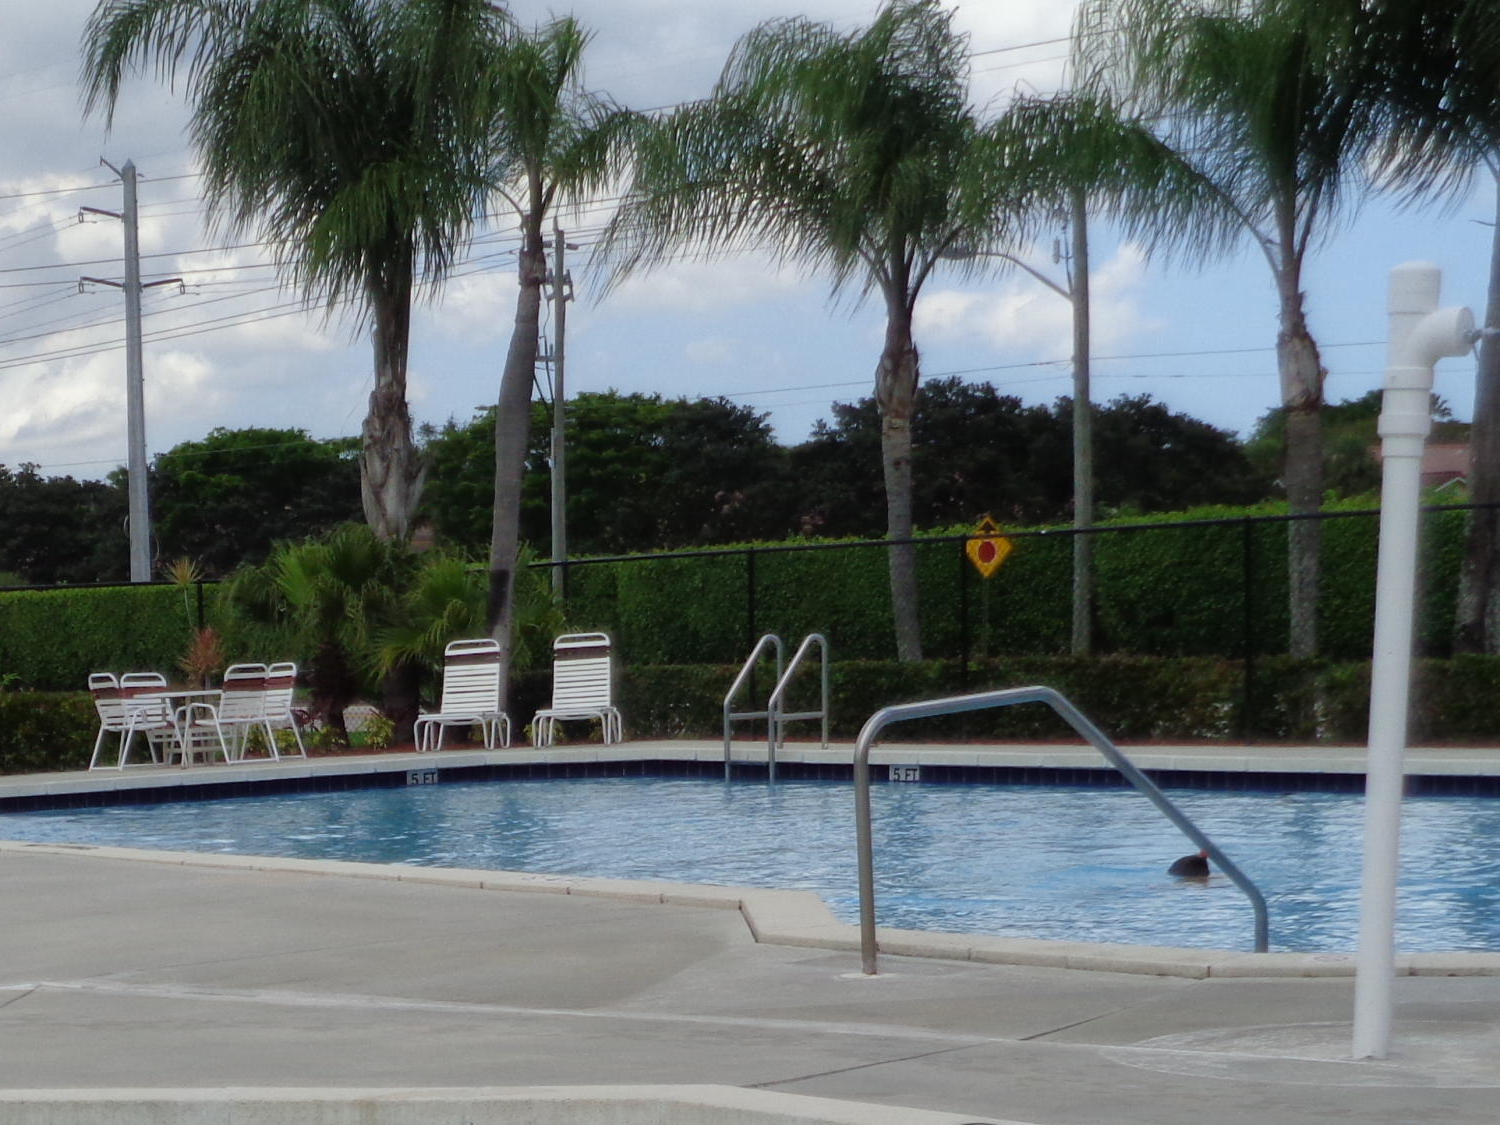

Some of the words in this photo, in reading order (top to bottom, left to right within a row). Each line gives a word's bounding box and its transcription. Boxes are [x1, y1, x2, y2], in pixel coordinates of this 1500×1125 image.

[411, 773, 419, 784] 5
[423, 772, 436, 783] FT
[894, 768, 900, 781] 5
[905, 768, 918, 780] FT
